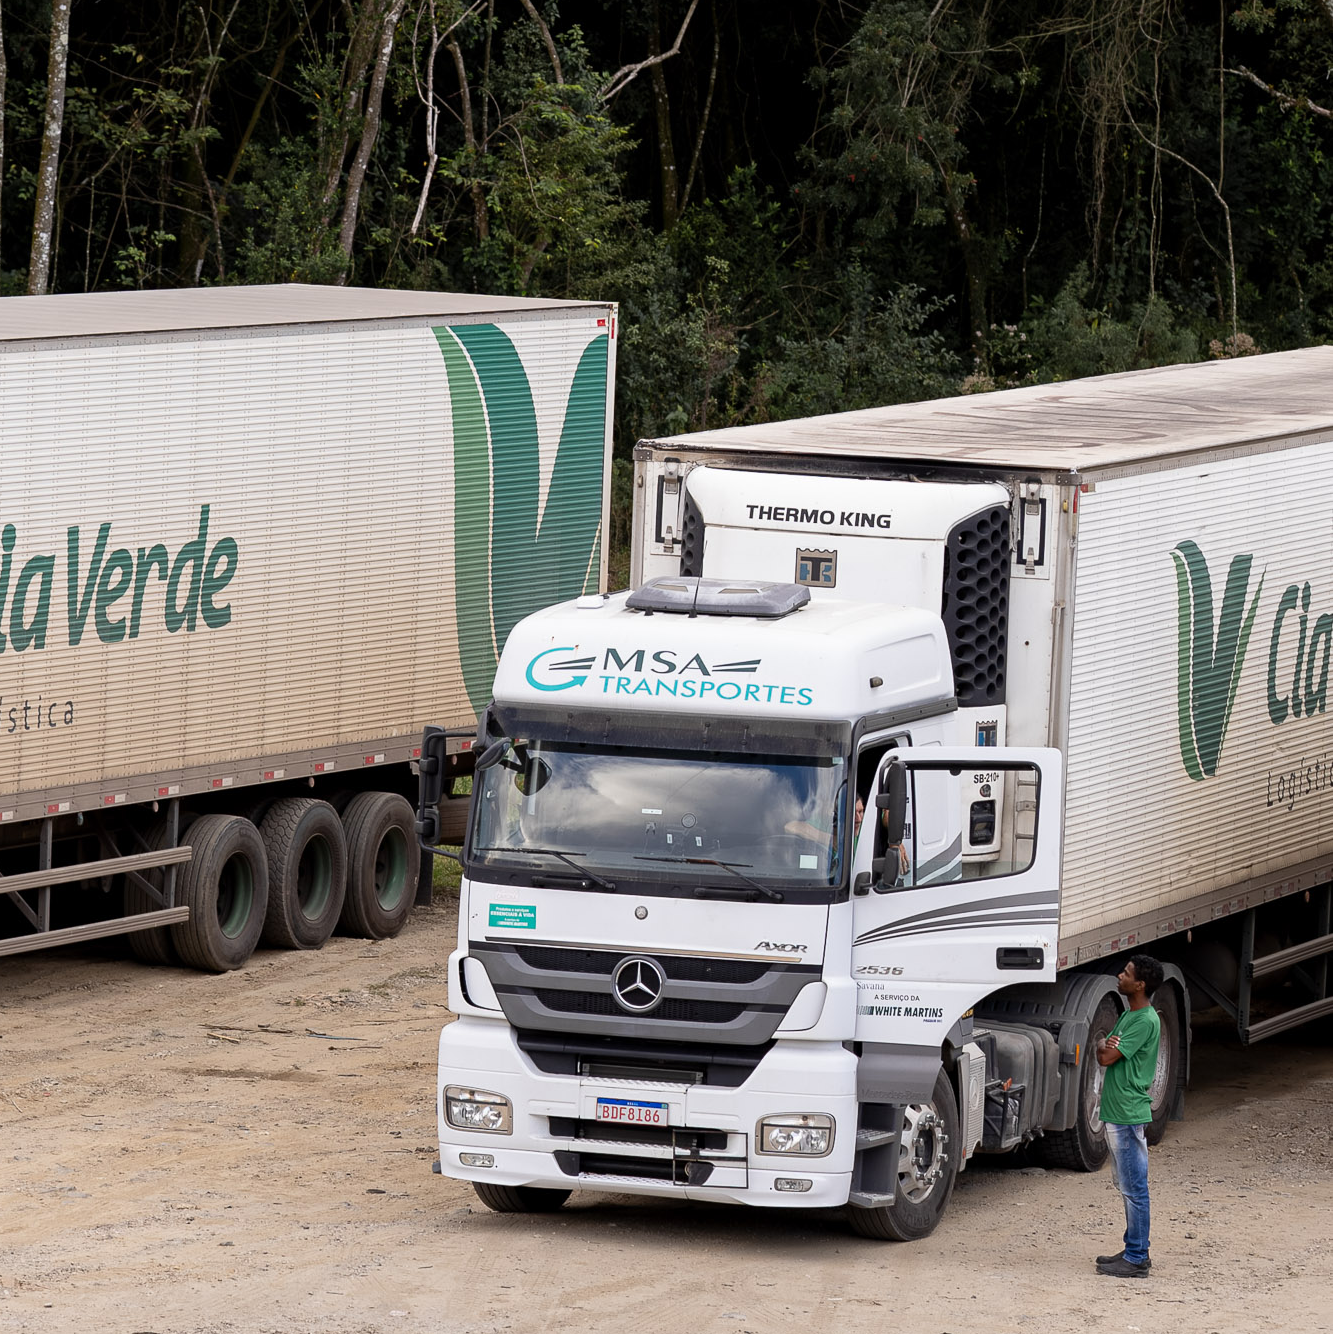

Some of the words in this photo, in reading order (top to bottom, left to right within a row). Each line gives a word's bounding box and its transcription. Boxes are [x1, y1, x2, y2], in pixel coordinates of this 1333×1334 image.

[746, 504, 835, 525] THERMO
[839, 511, 892, 529] KING
[603, 648, 711, 677] MSA
[599, 675, 813, 706] TRANSPORTES
[973, 772, 999, 784] SB-210+
[754, 941, 807, 953] AXOR
[855, 965, 904, 976] 2536
[856, 981, 885, 990] Savana
[880, 994, 909, 1002] SERVIÇO
[875, 1006, 902, 1017] WHITE
[903, 1008, 943, 1018] MARTINS
[602, 1105, 660, 1123] BDF8I86
